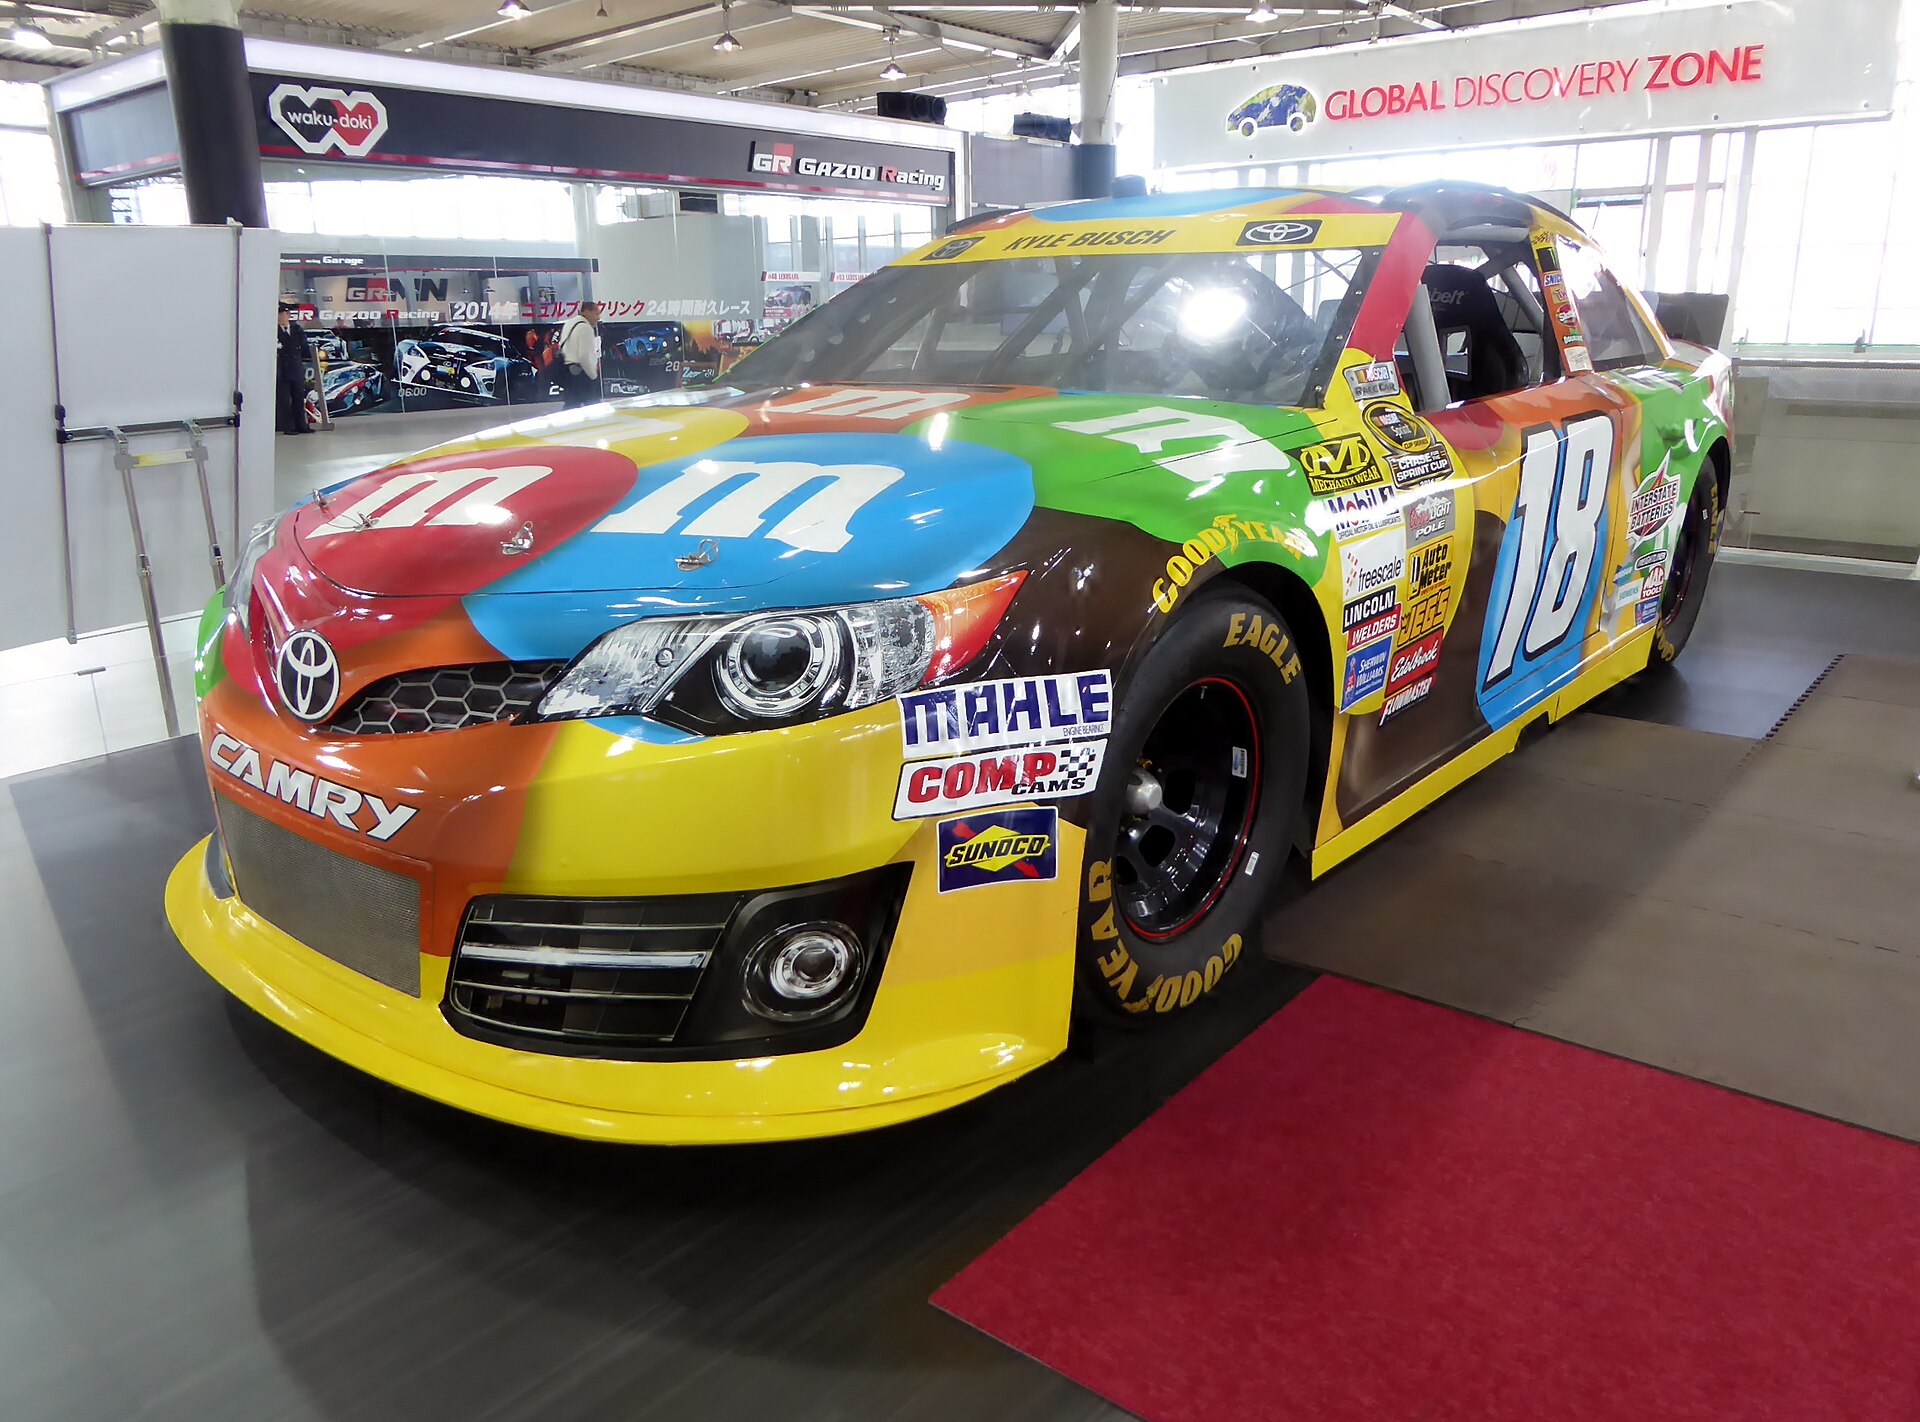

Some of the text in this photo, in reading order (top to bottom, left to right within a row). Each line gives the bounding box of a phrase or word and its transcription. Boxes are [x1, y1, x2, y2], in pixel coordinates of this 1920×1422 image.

[1324, 44, 1765, 121] GLOBAL DISCOVERY ZONE
[287, 109, 372, 130] waku-doki
[753, 153, 946, 191] GR GAZOO Racing
[1002, 229, 1177, 251] KYLE BUSCH
[322, 255, 364, 266] Garage
[319, 310, 382, 321] GAZOO
[385, 309, 440, 321] Racing
[1379, 381, 1398, 393] CAR
[1396, 459, 1448, 482] SPRINT CUP
[1398, 453, 1432, 471] CHASE
[1309, 465, 1381, 493] MECHANIX WEAR
[590, 459, 906, 553] m
[1631, 482, 1677, 513] INTERSTATE
[1416, 519, 1446, 540] POLE
[1631, 502, 1673, 529] BATTERIES
[1421, 543, 1449, 570] Auto
[1484, 412, 1613, 690] 18
[1358, 556, 1402, 592] freescale
[1420, 561, 1452, 589] Meter
[1642, 585, 1663, 598] TOOLS
[1344, 589, 1395, 628] LINCOLN
[1351, 613, 1398, 646] WELDERS
[1223, 612, 1303, 685] EAGLE
[1358, 651, 1387, 674] SHERWIN
[1390, 639, 1440, 683] Edelbrock
[1355, 665, 1385, 688] WILLIAMS
[900, 673, 1110, 746] MAHLE
[1379, 676, 1433, 727] FLOWMASTER
[210, 732, 420, 842] CAMRY
[907, 752, 1057, 804] COMP
[1011, 777, 1087, 796] CAMS
[950, 836, 1047, 866] SUNOCO
[1088, 857, 1243, 1014] GOODYEAR
